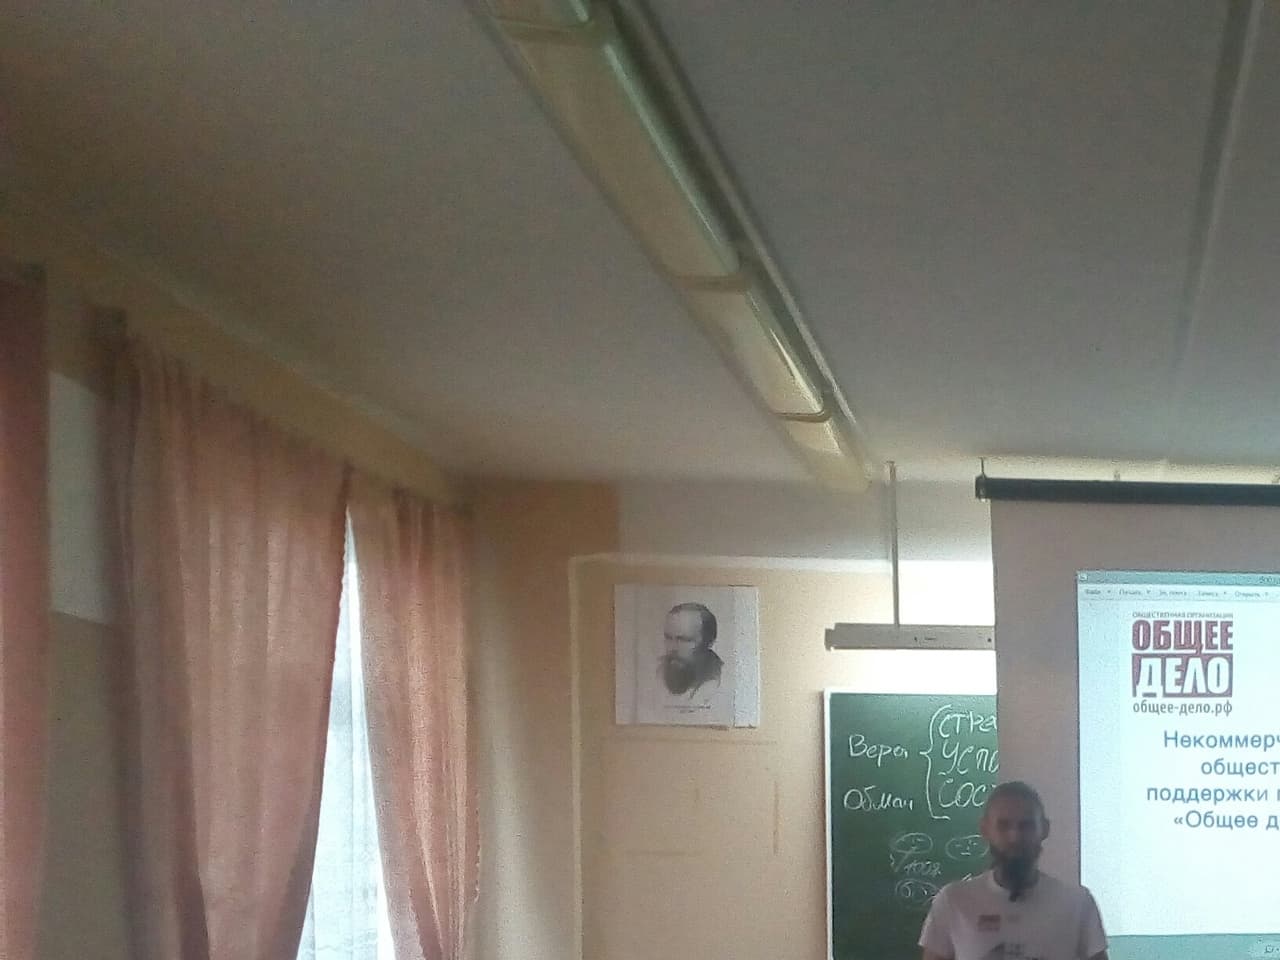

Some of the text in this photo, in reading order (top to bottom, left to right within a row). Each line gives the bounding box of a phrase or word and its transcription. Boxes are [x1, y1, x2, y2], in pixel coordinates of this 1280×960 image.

[1132, 619, 1234, 653] ОБЩЕЕ
[1136, 656, 1231, 697] ДЕЛО
[1132, 701, 1233, 716] общее-дело.рф
[1146, 787, 1269, 806] поддержки
[1173, 810, 1259, 830] «Общее
